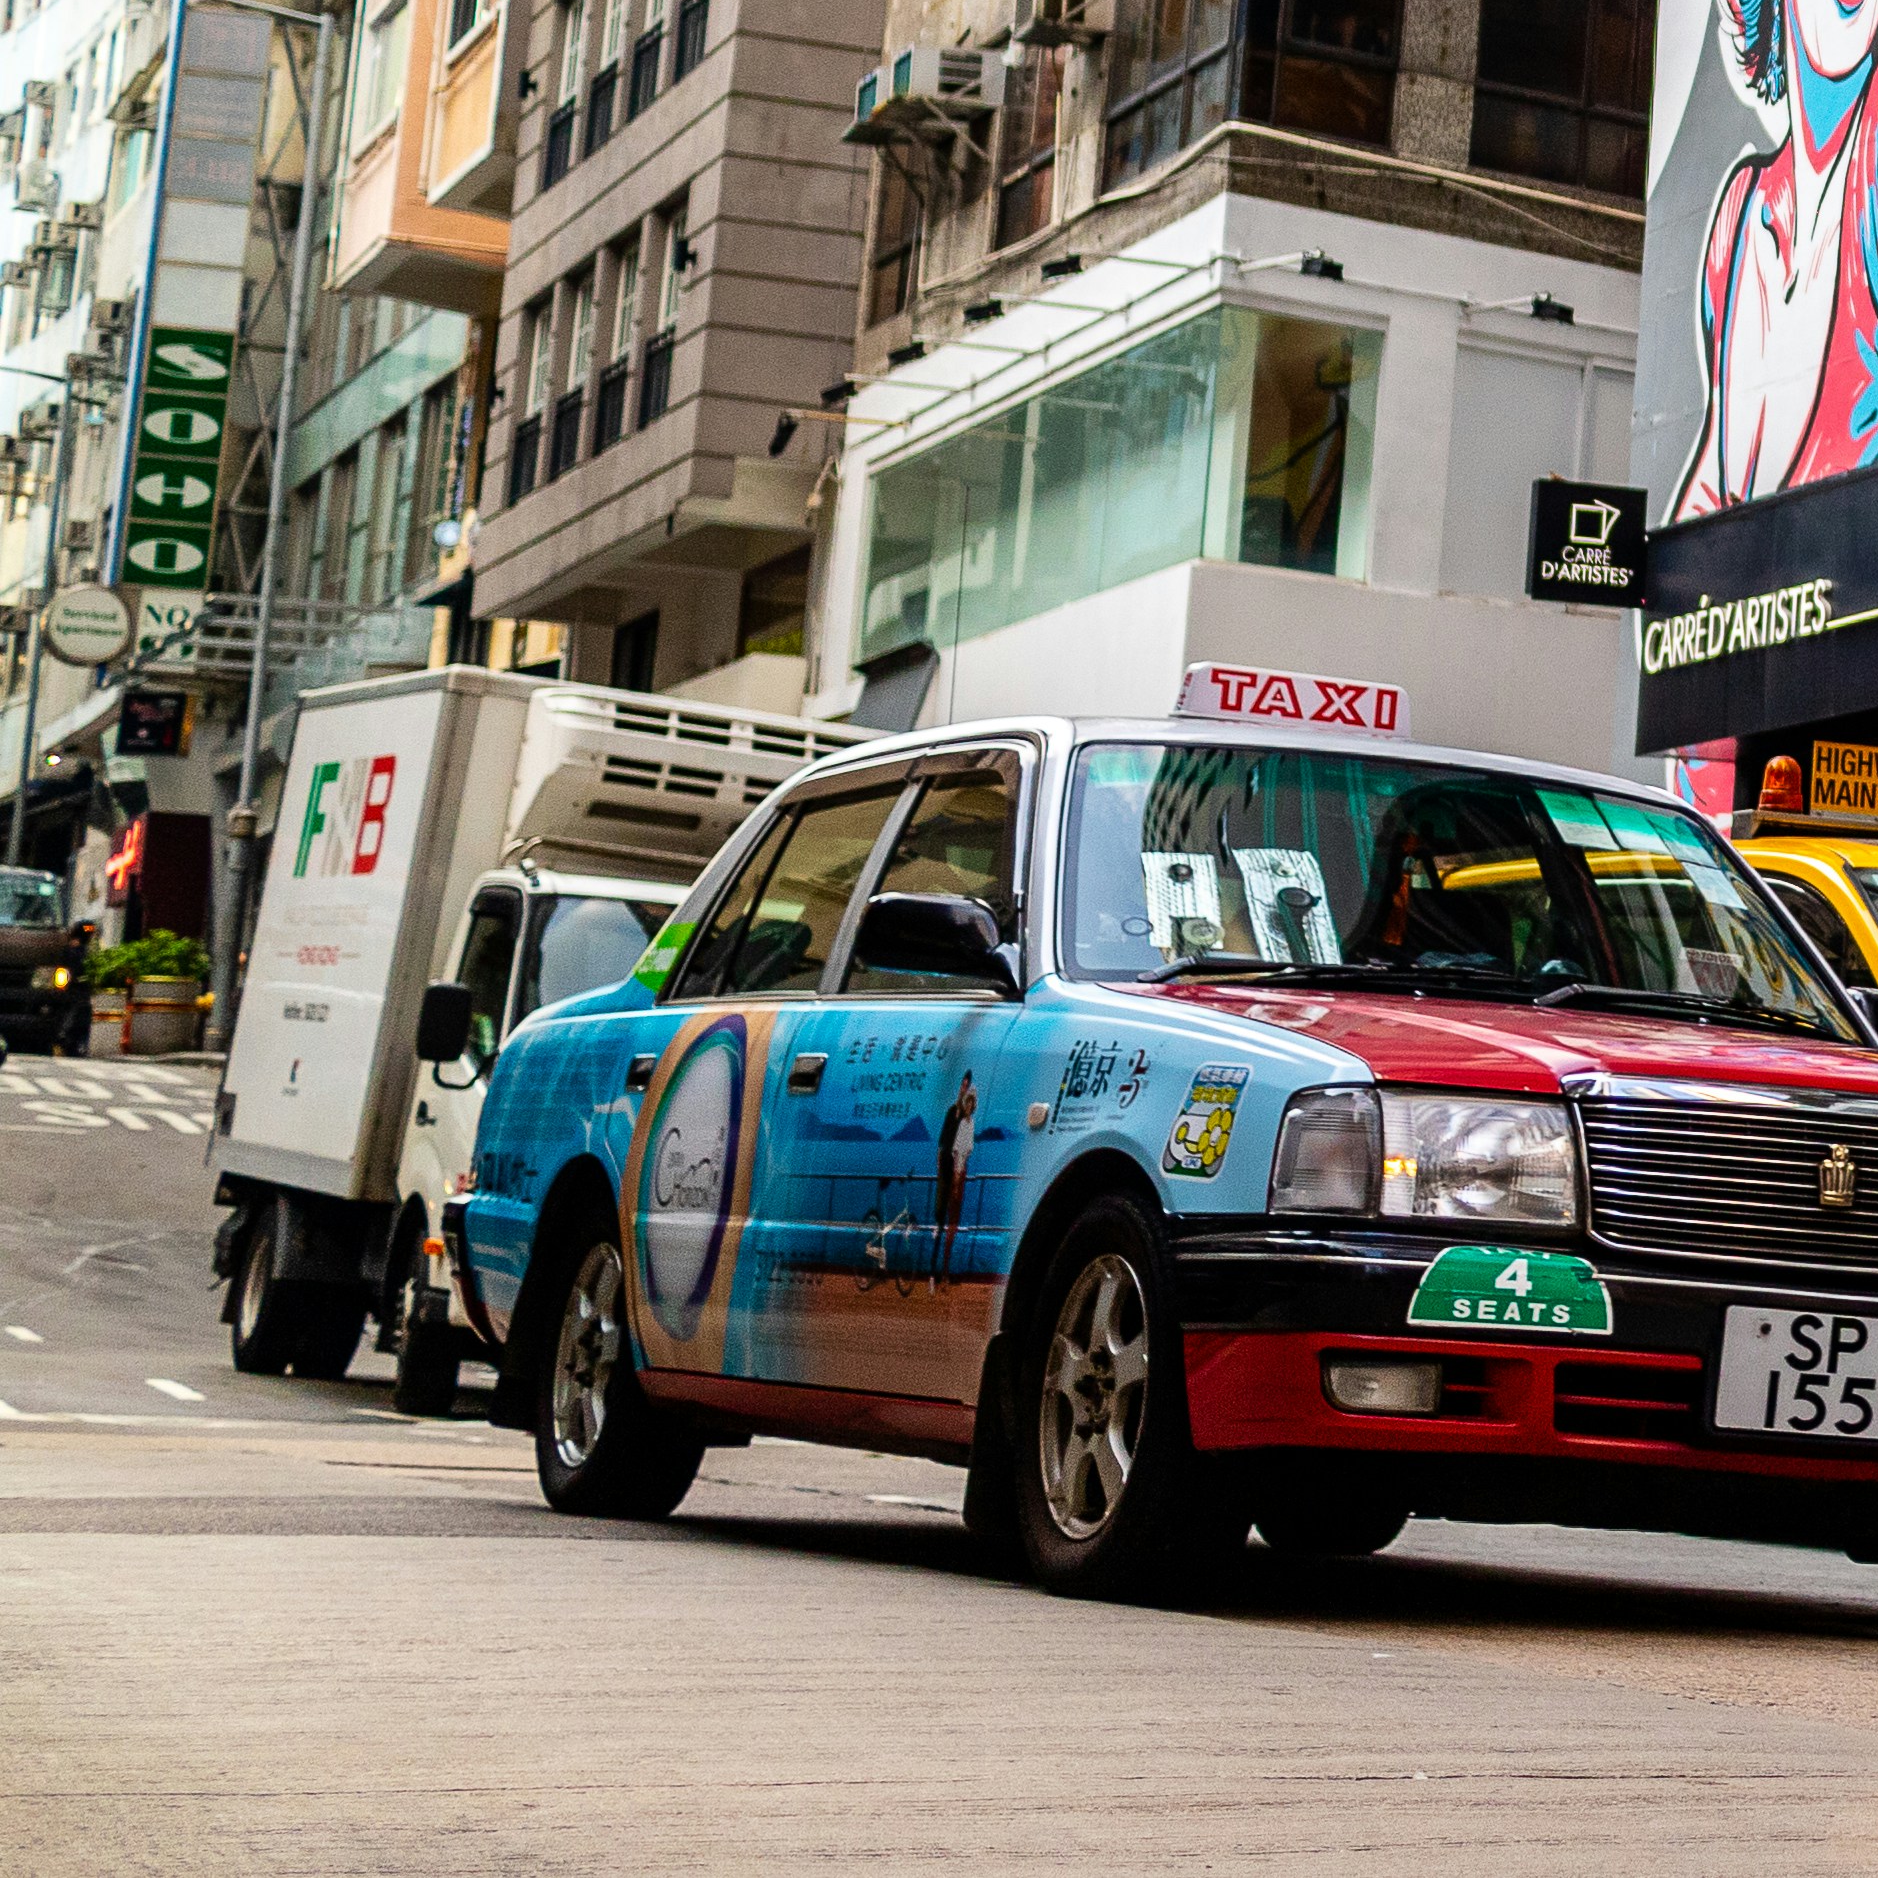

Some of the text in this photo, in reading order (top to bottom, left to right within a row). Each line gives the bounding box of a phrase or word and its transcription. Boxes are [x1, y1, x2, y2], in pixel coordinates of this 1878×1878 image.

[127, 342, 228, 574] SOHO
[1562, 546, 1612, 566] CARRÉ
[1211, 668, 1398, 730] TAXI
[1494, 1258, 1533, 1297] 4
[1451, 1298, 1571, 1324] SEATS
[1783, 1313, 1869, 1374] SP
[1763, 1370, 1877, 1435] 155
